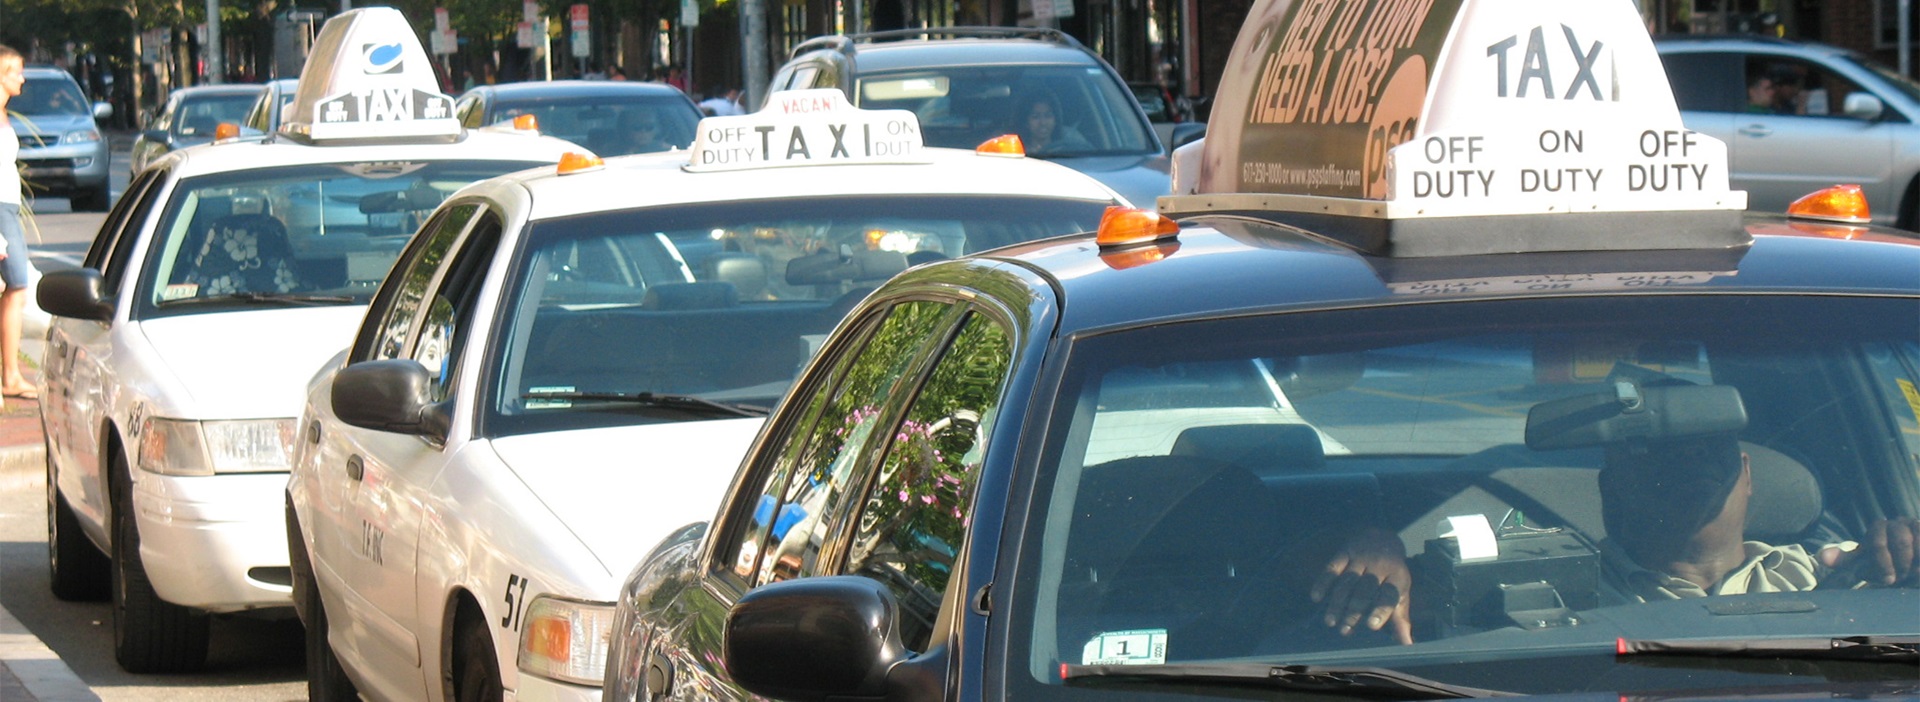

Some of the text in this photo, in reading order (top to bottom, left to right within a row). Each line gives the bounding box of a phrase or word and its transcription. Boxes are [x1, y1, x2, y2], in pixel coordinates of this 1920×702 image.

[1278, 0, 1434, 54] NEW TO TOWN
[1486, 22, 1620, 102] TAXI
[1250, 48, 1395, 124] NEED A JOB?
[350, 88, 413, 121] TAXI
[782, 96, 838, 114] VACANT
[708, 127, 747, 144] OFF
[755, 123, 871, 160] TAXI
[887, 120, 914, 135] ON
[1539, 129, 1583, 153] ON
[702, 147, 756, 164] DUTY
[875, 140, 912, 157] DUT
[1425, 136, 1484, 164] OFF
[1640, 129, 1697, 157] OFF
[1413, 169, 1496, 198] DUTY
[1520, 168, 1604, 192] DUTY
[1628, 164, 1709, 192] DUTY
[501, 573, 528, 632] 51
[1116, 640, 1131, 656] 1
